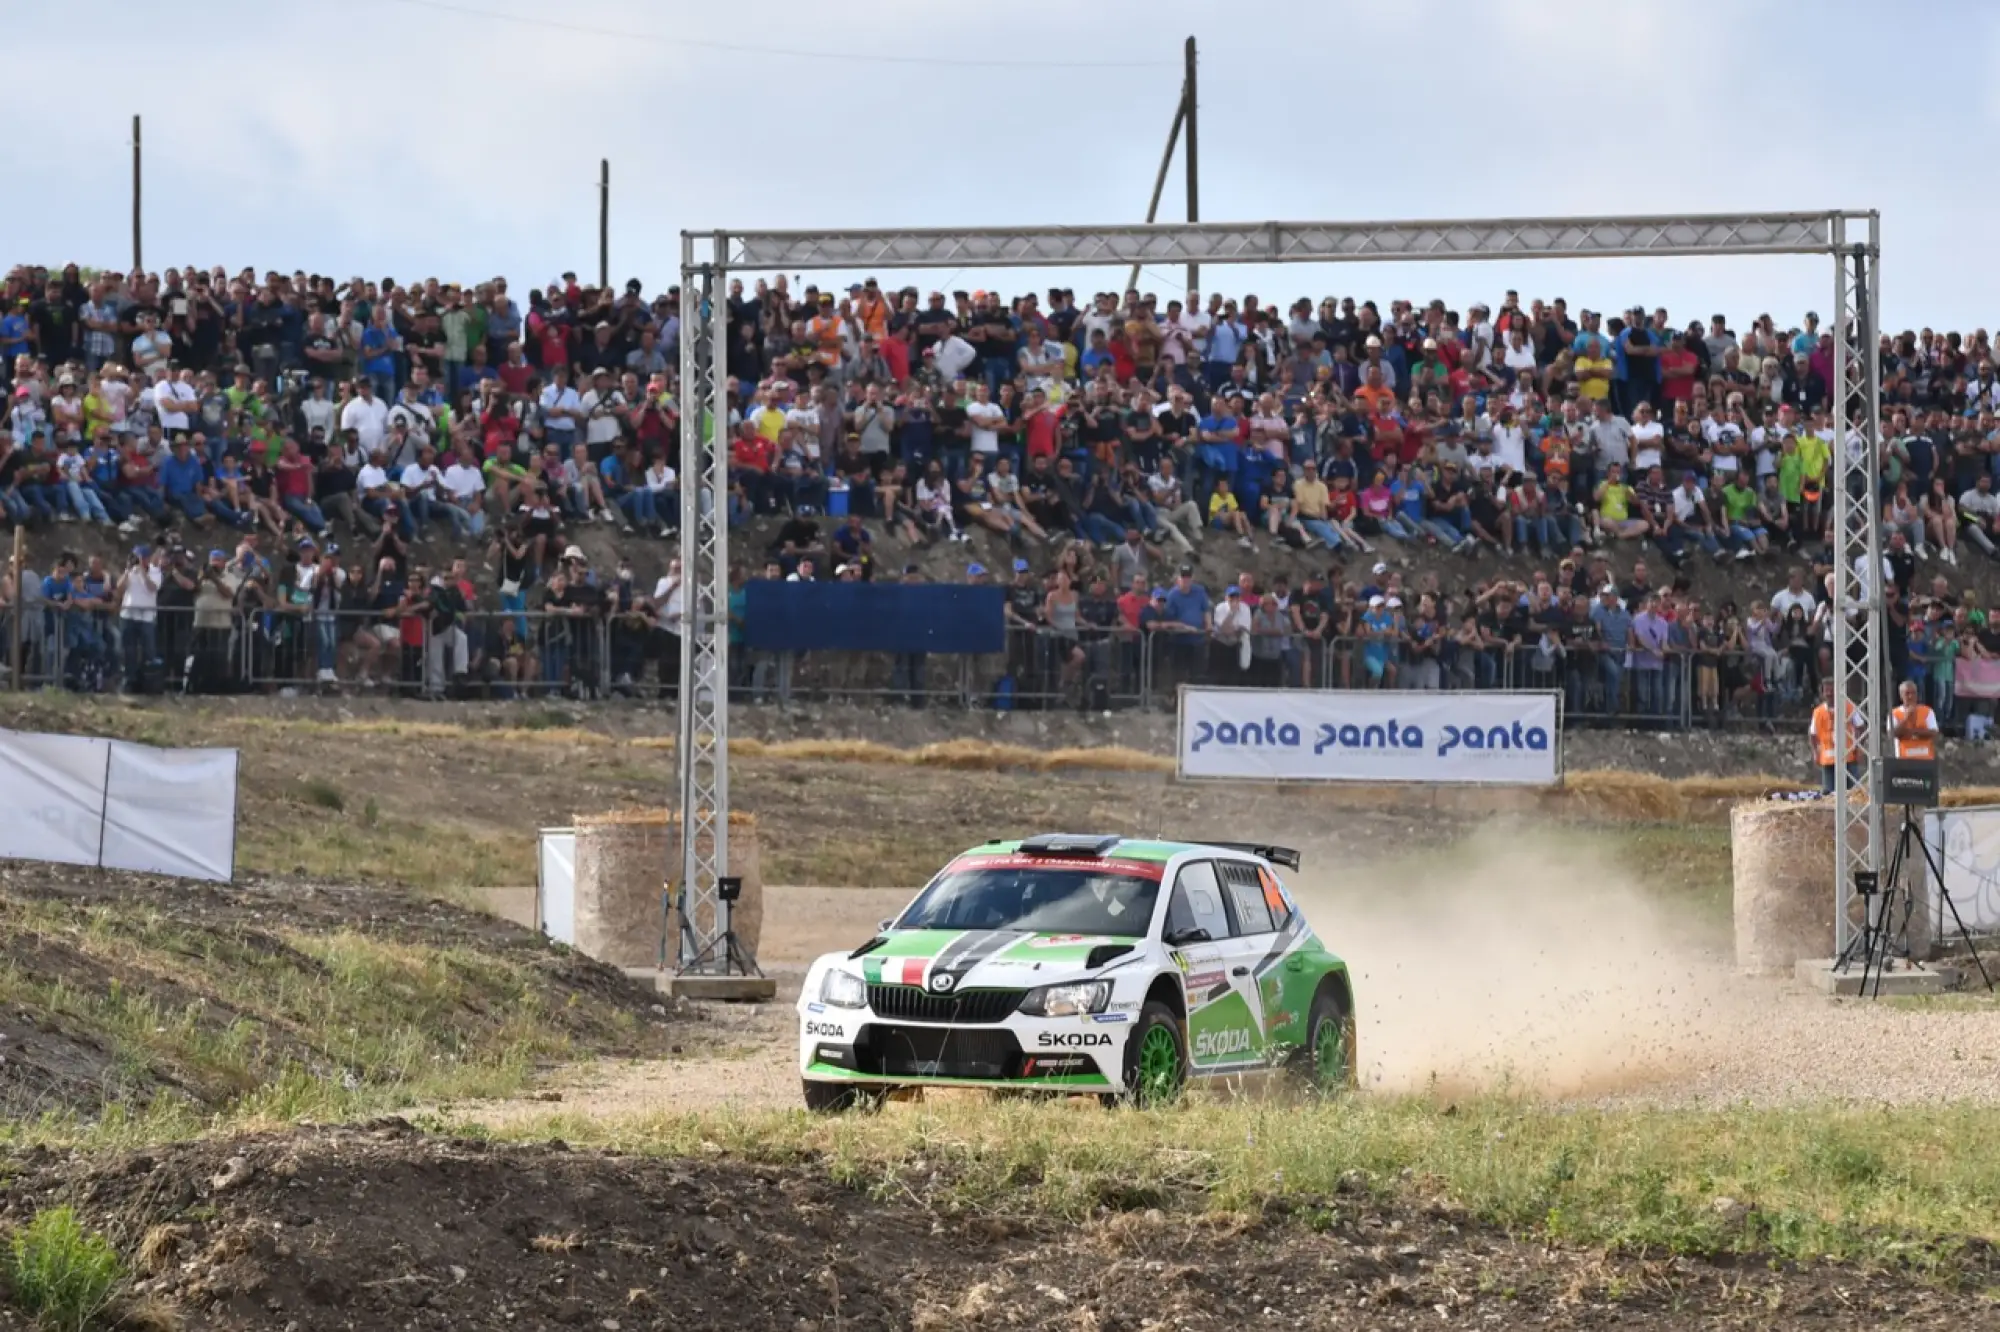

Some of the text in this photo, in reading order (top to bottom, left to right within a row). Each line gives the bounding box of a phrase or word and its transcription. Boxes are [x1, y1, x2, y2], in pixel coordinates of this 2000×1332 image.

[1191, 717, 1548, 757] panta panta panta
[1038, 1030, 1113, 1046] ŠKODA
[1195, 1027, 1250, 1057] ŠKODA
